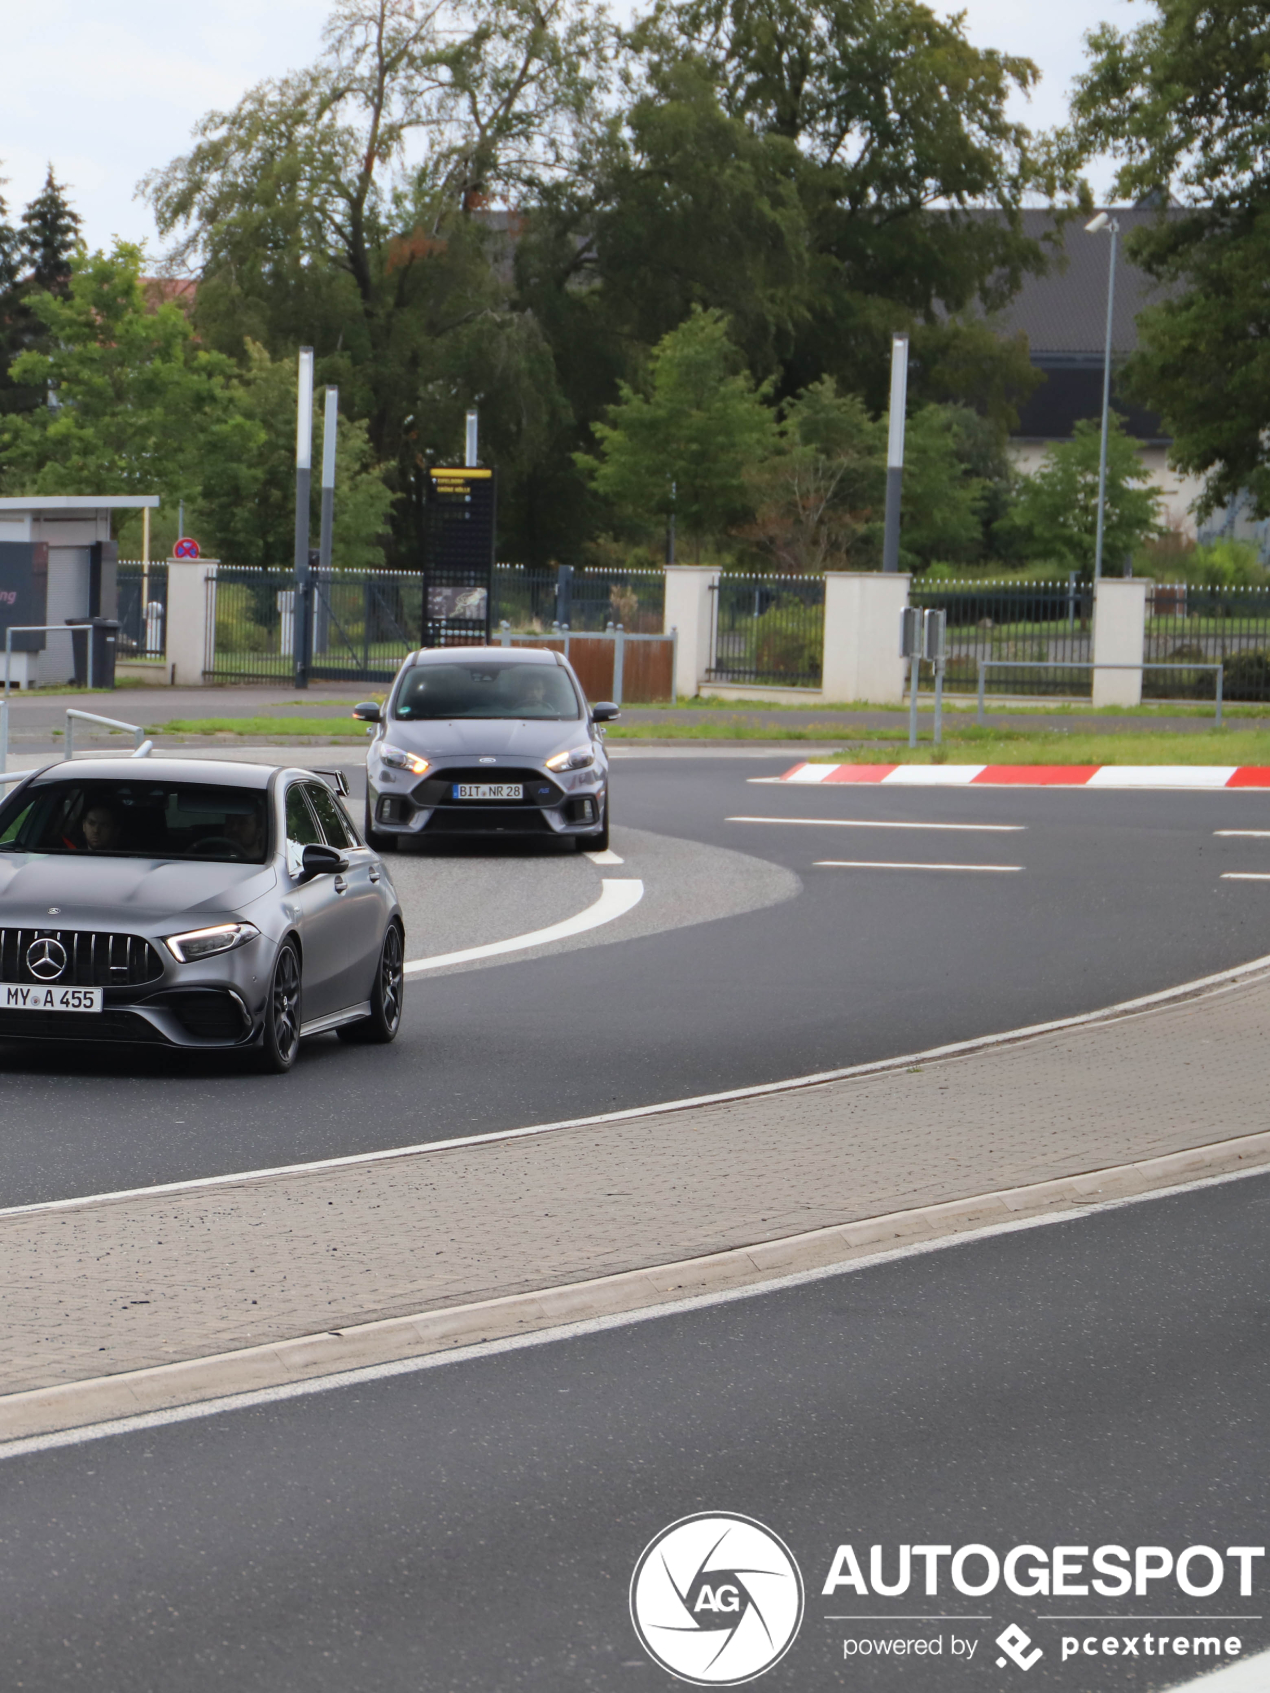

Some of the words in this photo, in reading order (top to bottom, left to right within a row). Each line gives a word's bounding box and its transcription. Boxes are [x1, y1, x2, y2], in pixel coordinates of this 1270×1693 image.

[459, 785, 481, 797] BIT
[488, 785, 504, 797] NR
[506, 785, 521, 798] 28
[7, 987, 31, 1006] MY
[43, 989, 55, 1008] A
[59, 990, 95, 1009] 455
